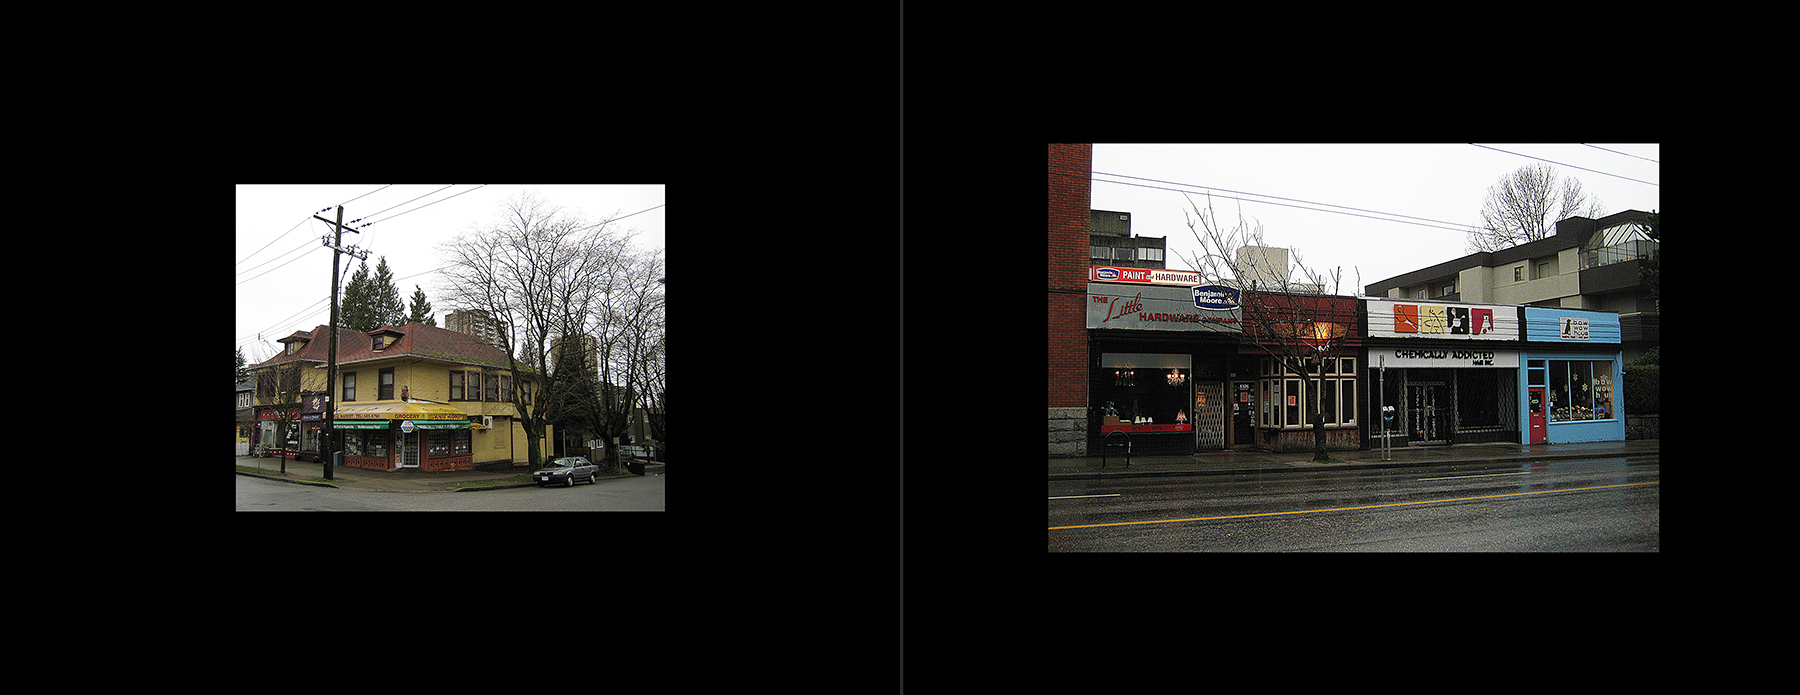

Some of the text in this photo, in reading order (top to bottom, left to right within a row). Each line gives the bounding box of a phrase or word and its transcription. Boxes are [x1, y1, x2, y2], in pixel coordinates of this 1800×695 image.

[1122, 271, 1146, 280] PAINT
[1155, 273, 1198, 283] HARDWARE
[1194, 289, 1226, 299] Benjamin
[1103, 292, 1143, 322] Little
[1140, 312, 1200, 323] HARDWARE
[1452, 350, 1494, 359] ADDICTED
